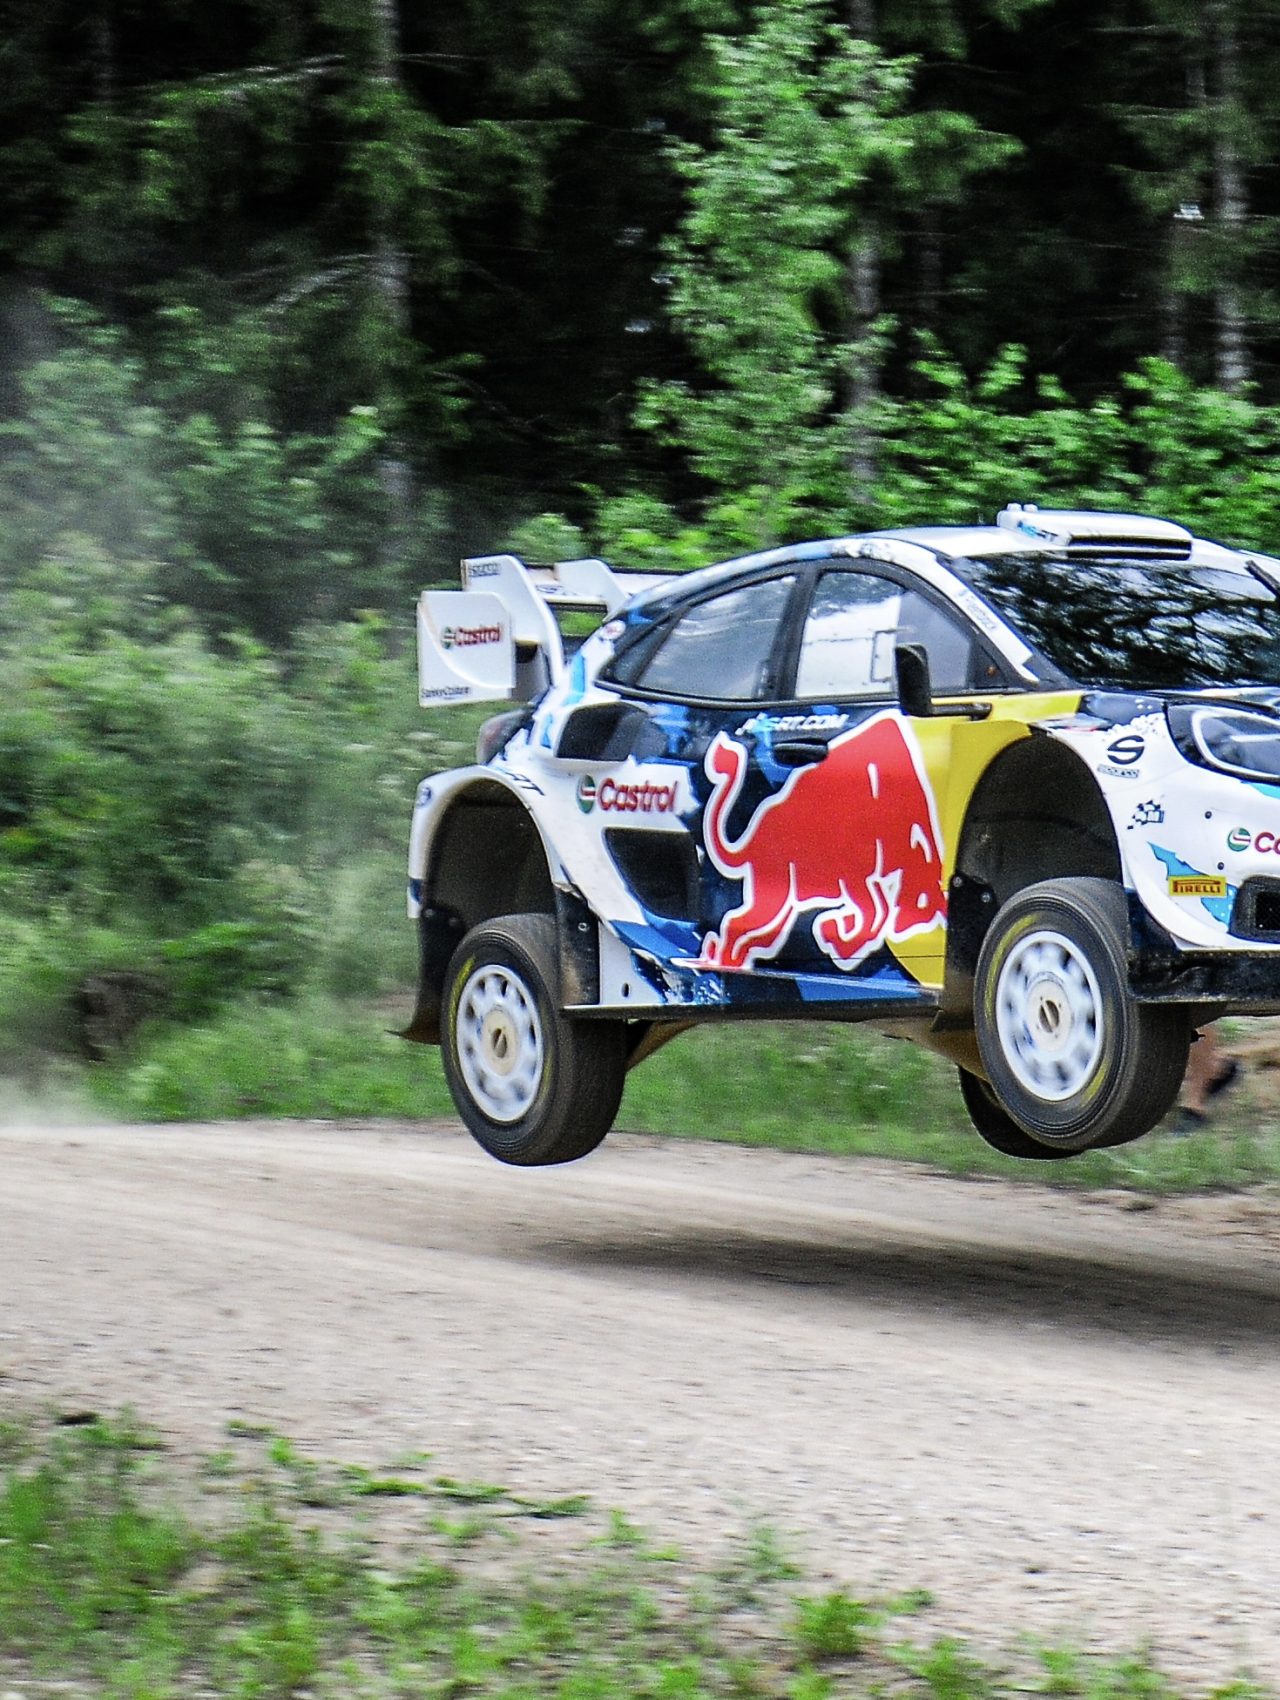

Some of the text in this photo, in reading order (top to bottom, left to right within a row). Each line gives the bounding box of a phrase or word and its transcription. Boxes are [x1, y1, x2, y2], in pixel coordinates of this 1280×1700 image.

[455, 622, 502, 647] Castrol
[600, 777, 679, 812] Castrol
[1172, 879, 1221, 893] PIRELLI
